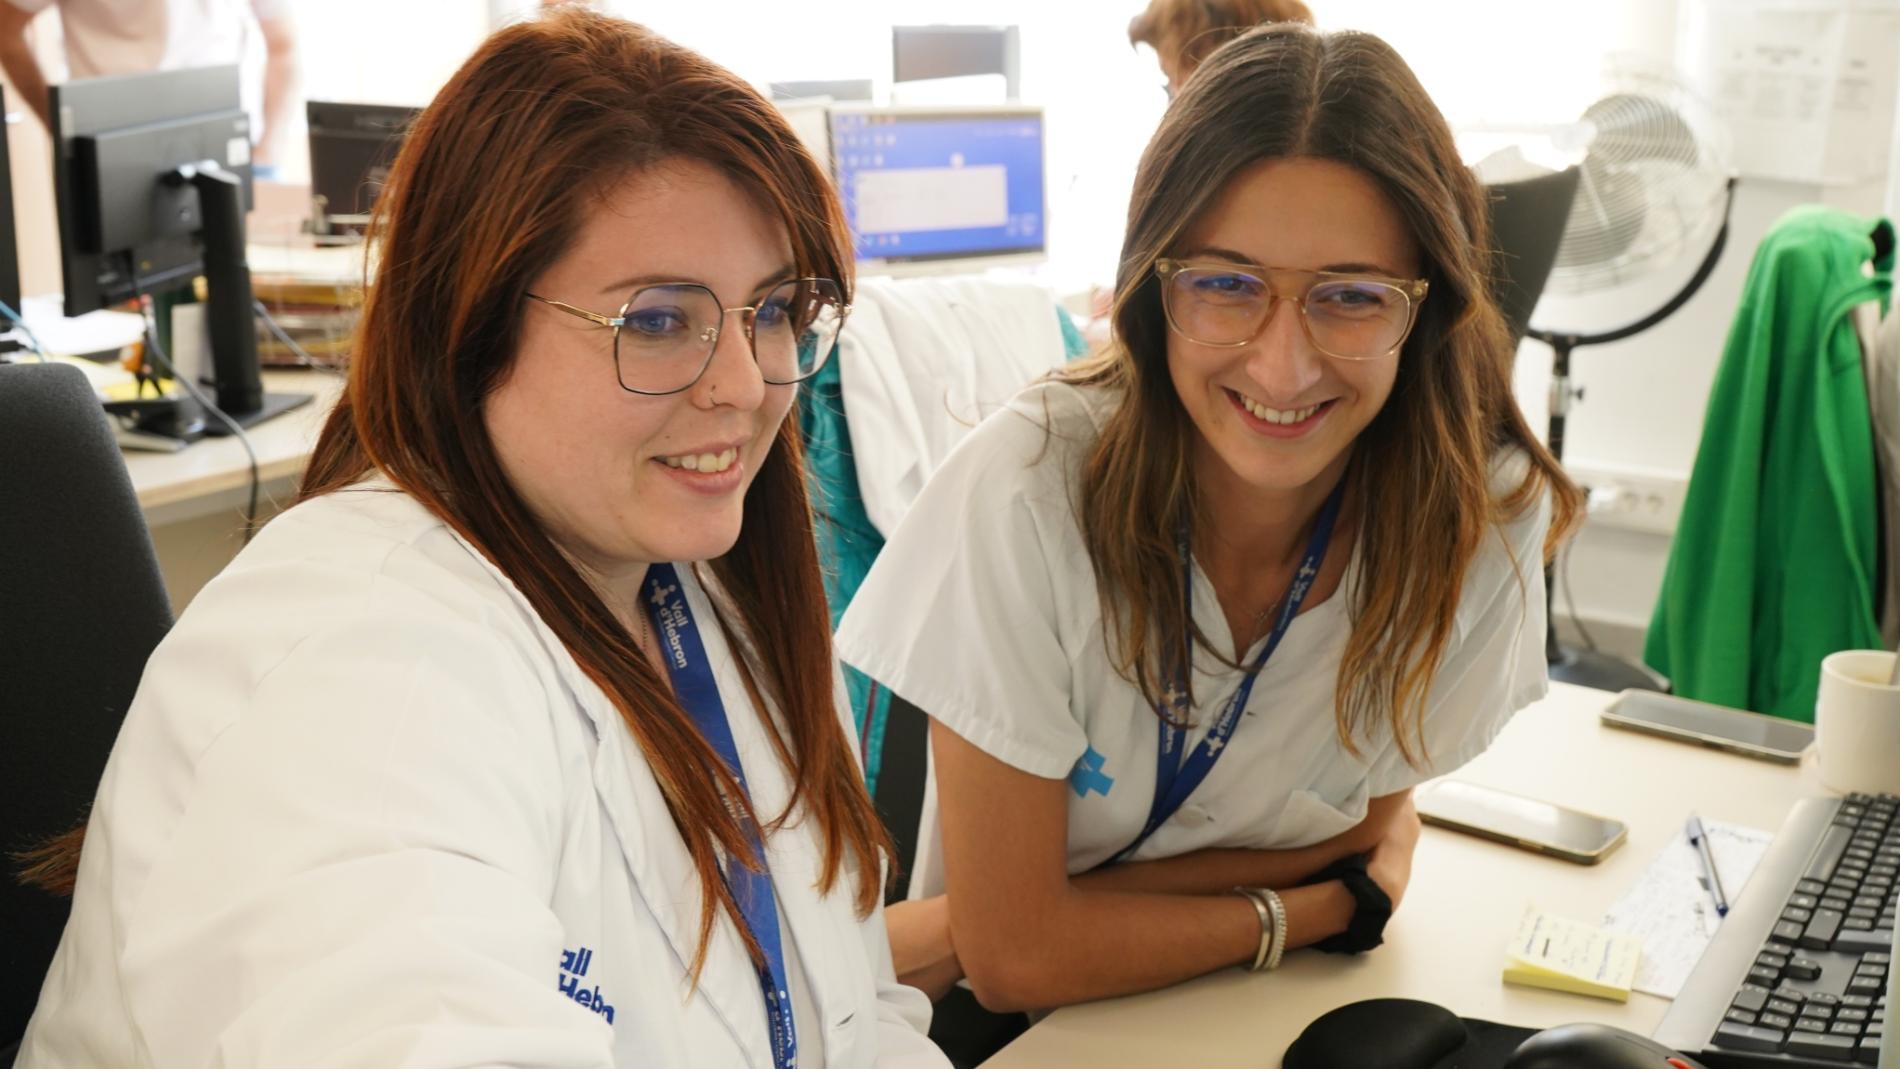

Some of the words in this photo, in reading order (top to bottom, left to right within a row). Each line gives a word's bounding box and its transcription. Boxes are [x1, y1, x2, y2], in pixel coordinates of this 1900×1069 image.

[670, 599, 689, 627] Vall
[659, 607, 688, 669] d'Hebron
[559, 946, 593, 977] all
